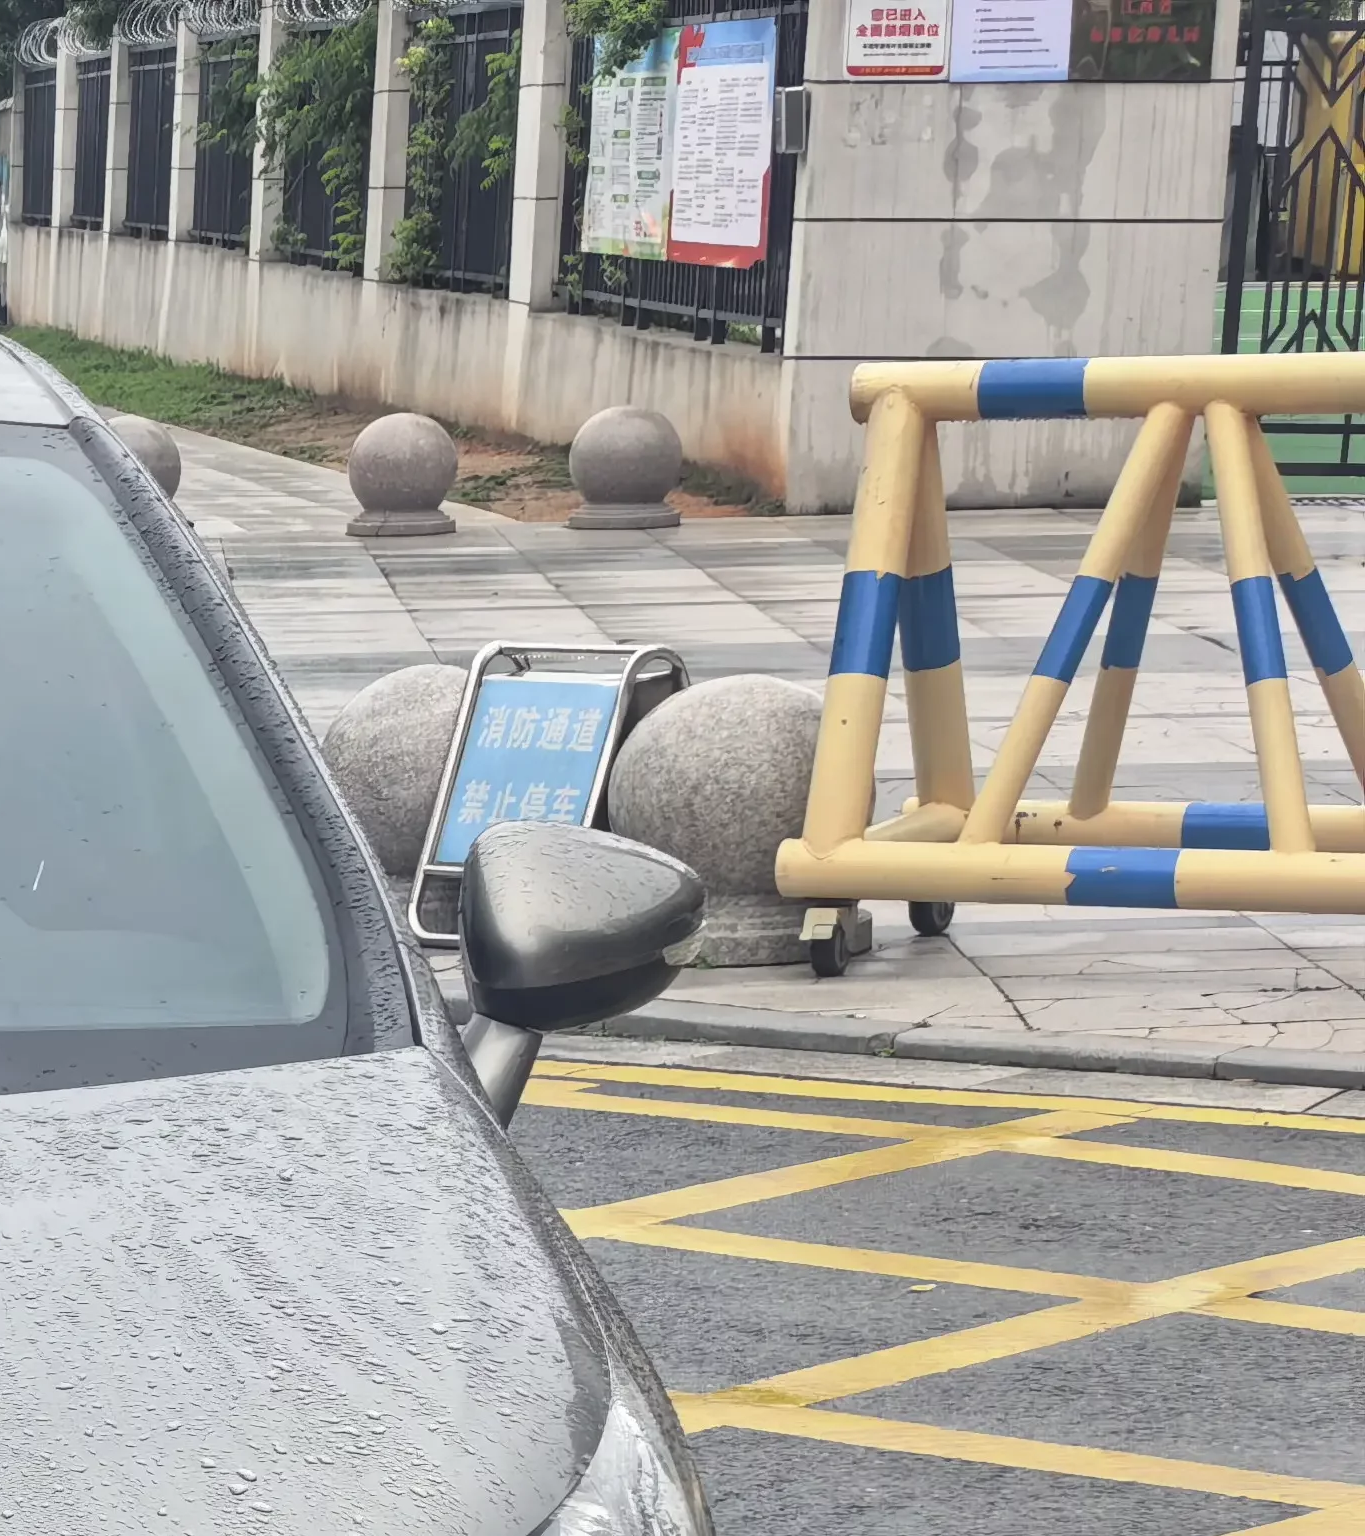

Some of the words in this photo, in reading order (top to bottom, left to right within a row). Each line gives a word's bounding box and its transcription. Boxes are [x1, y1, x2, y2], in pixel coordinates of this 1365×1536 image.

[477, 705, 604, 752] 消防通道
[457, 779, 581, 824] 禁止停车
